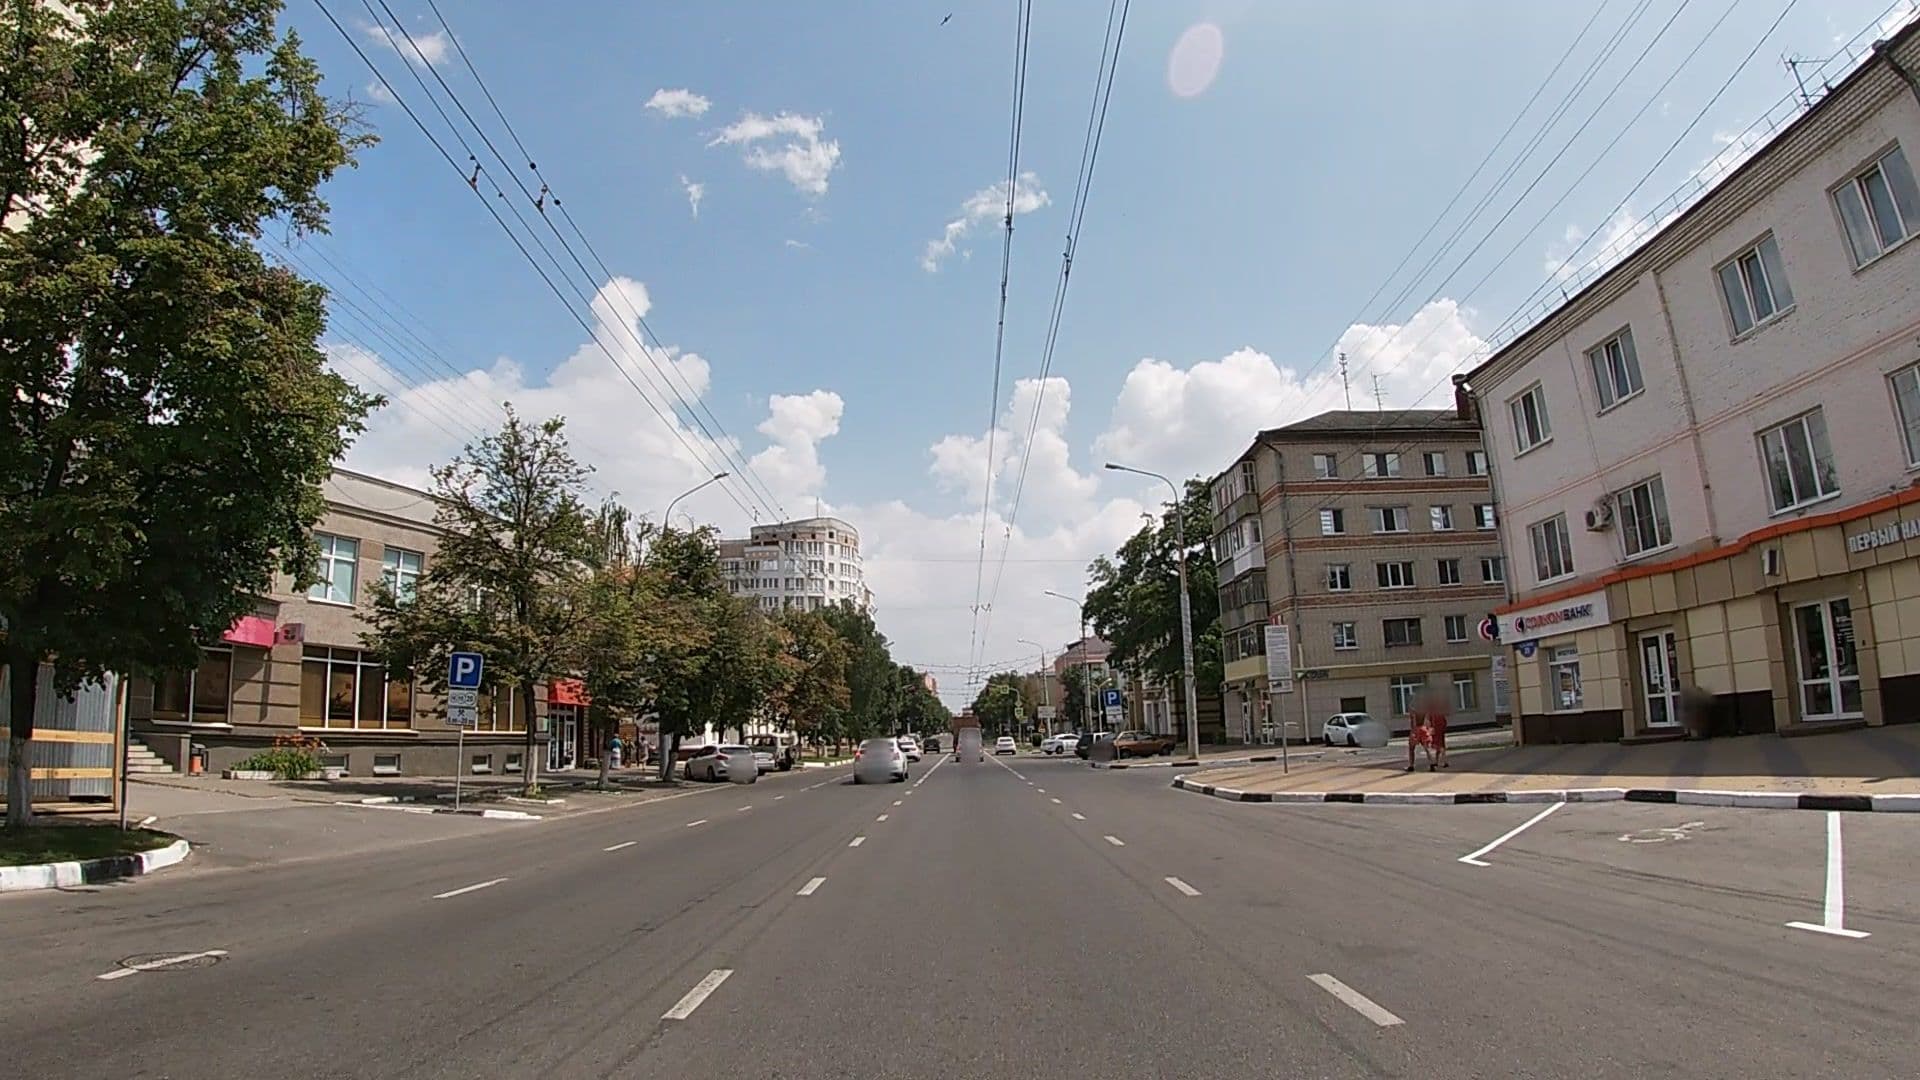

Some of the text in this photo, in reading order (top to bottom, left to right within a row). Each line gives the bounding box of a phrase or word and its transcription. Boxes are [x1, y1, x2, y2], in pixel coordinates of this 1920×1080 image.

[1848, 521, 1900, 552] ПЕРВЫЙ
[456, 657, 475, 682] P
[1107, 691, 1117, 705] P
